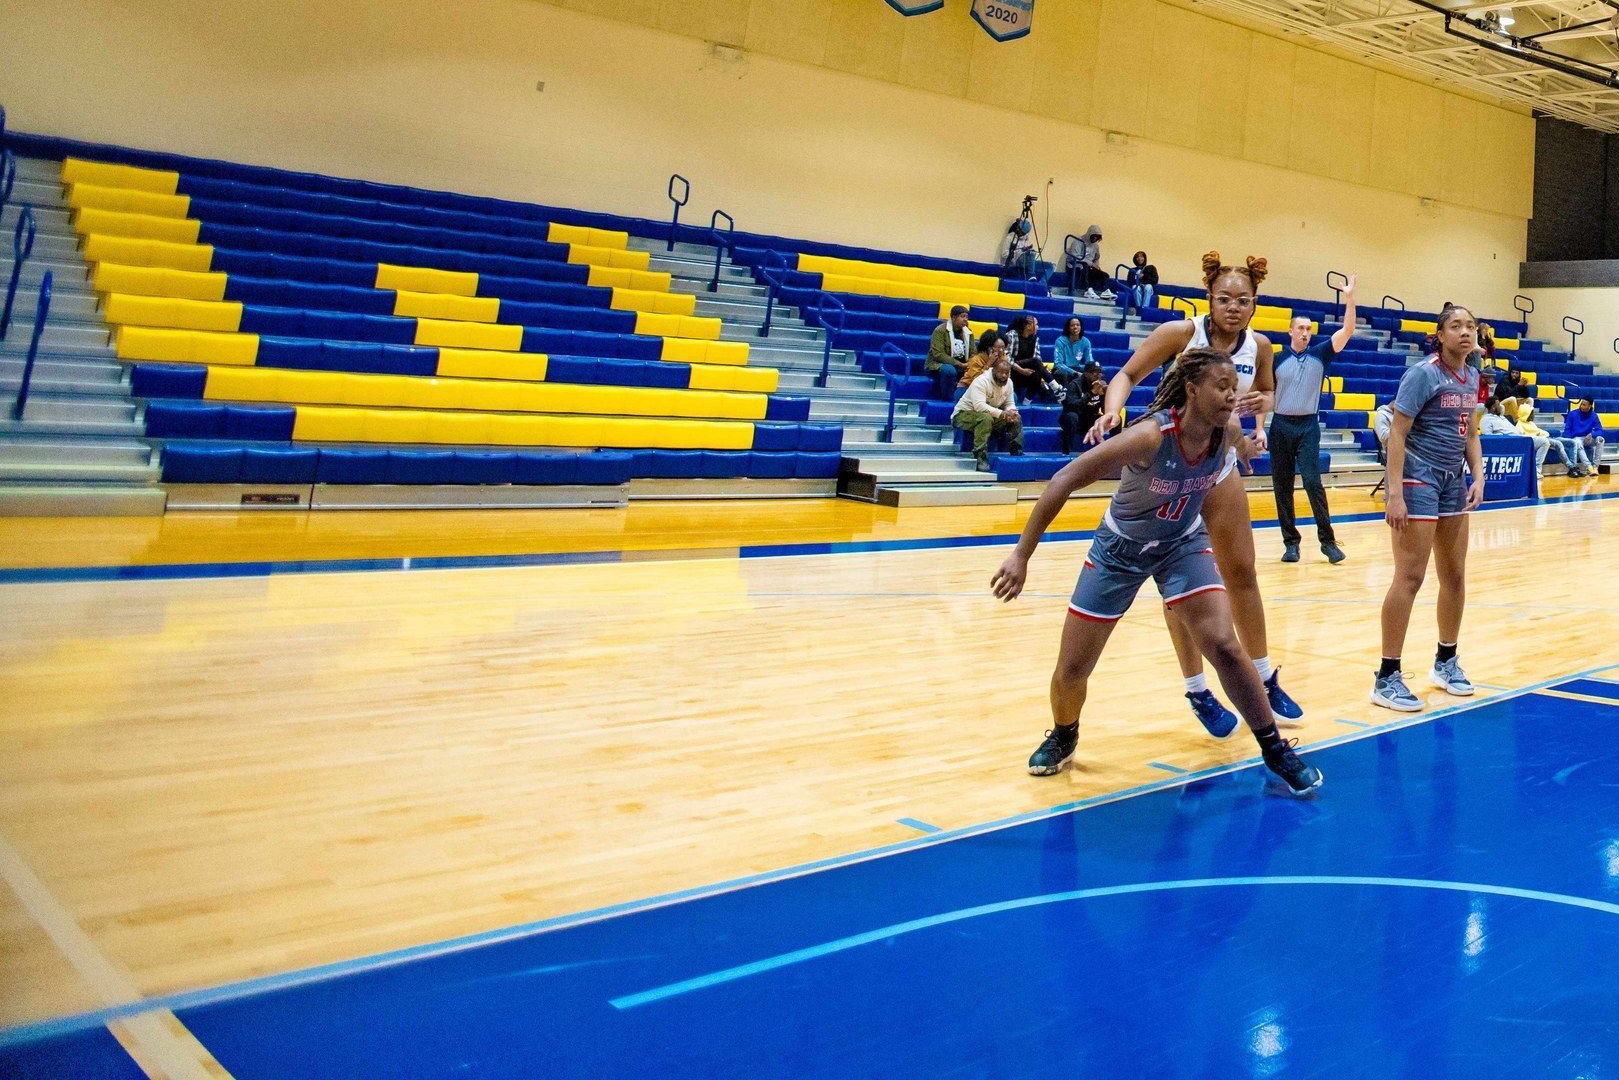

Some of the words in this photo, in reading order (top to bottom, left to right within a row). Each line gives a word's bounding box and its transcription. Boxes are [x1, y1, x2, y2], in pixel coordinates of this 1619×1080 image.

[985, 5, 1018, 24] 2020
[1236, 364, 1253, 375] ECH
[1458, 412, 1469, 436] 5
[1491, 456, 1522, 474] TECH
[1149, 476, 1180, 494] RED
[1156, 494, 1191, 522] 11
